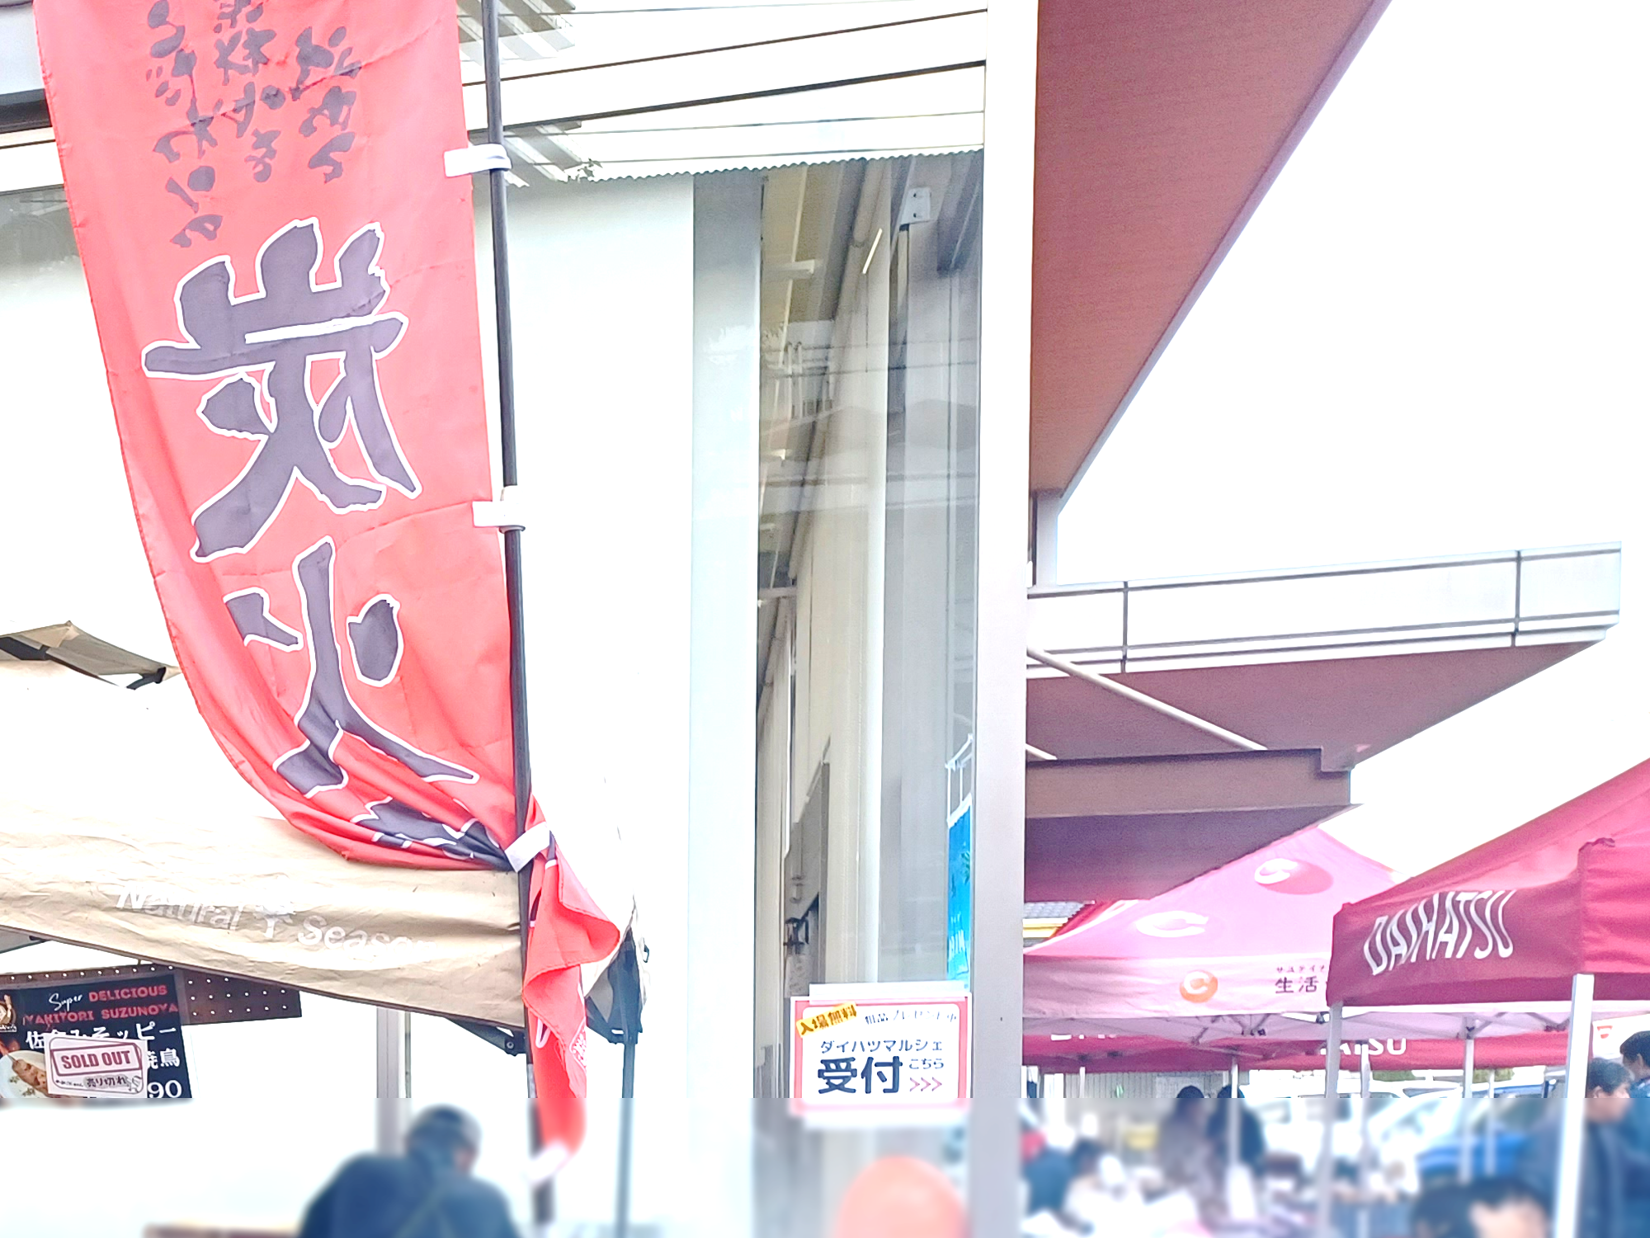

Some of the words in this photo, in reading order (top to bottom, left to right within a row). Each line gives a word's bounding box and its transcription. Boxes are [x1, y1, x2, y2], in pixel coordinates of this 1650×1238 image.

[1362, 889, 1519, 977] DAIHATSU
[1274, 976, 1319, 994] 生活
[48, 993, 83, 1012] Super
[88, 985, 168, 1002] DELICIOUS
[22, 1009, 94, 1026] YAKITORI
[101, 1003, 179, 1020] SUZUNOYA
[800, 1003, 858, 1036] 入場無料
[820, 1039, 943, 1054] ダイハツマルシェ
[60, 1054, 100, 1070] SOLD
[102, 1050, 132, 1066] OUT
[817, 1055, 904, 1094] 受付
[908, 1058, 945, 1070] こちら
